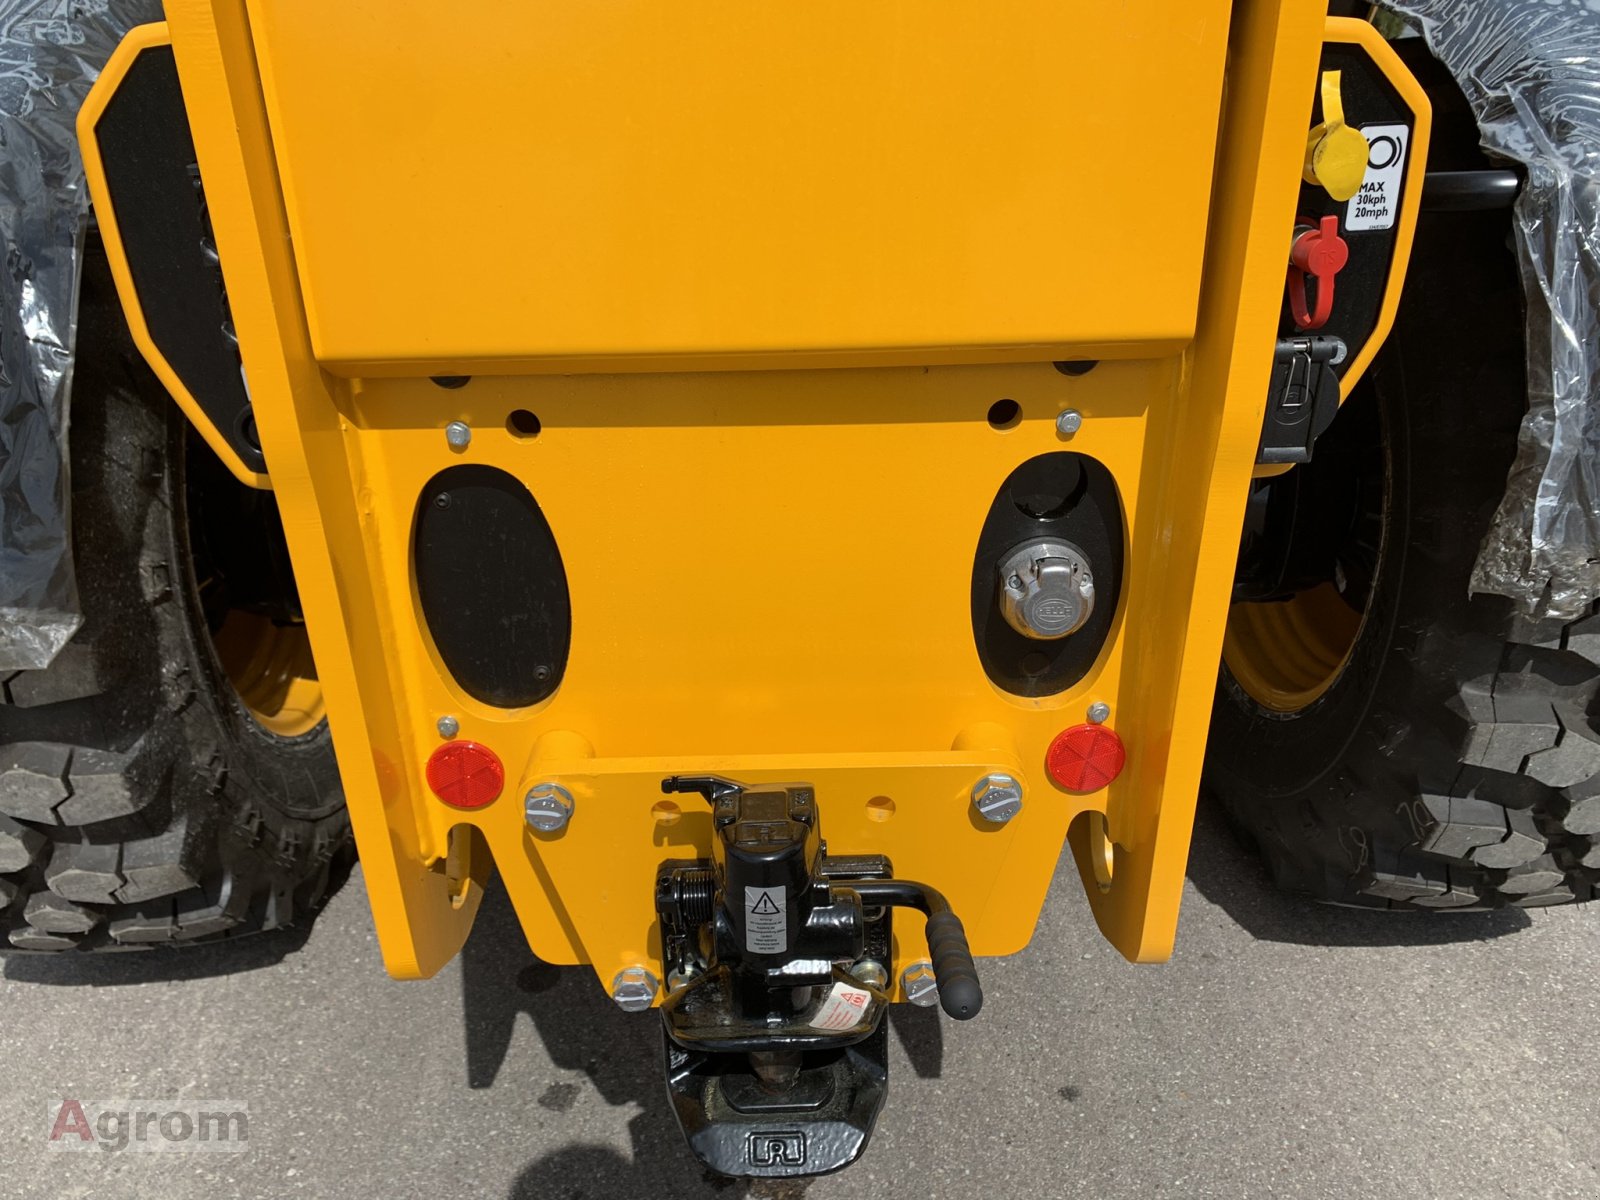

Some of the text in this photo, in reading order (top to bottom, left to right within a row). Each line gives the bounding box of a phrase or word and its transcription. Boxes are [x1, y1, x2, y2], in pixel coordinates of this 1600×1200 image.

[1359, 181, 1386, 193] MAX
[1356, 194, 1386, 208] 30kph
[1355, 206, 1389, 220] 20mph
